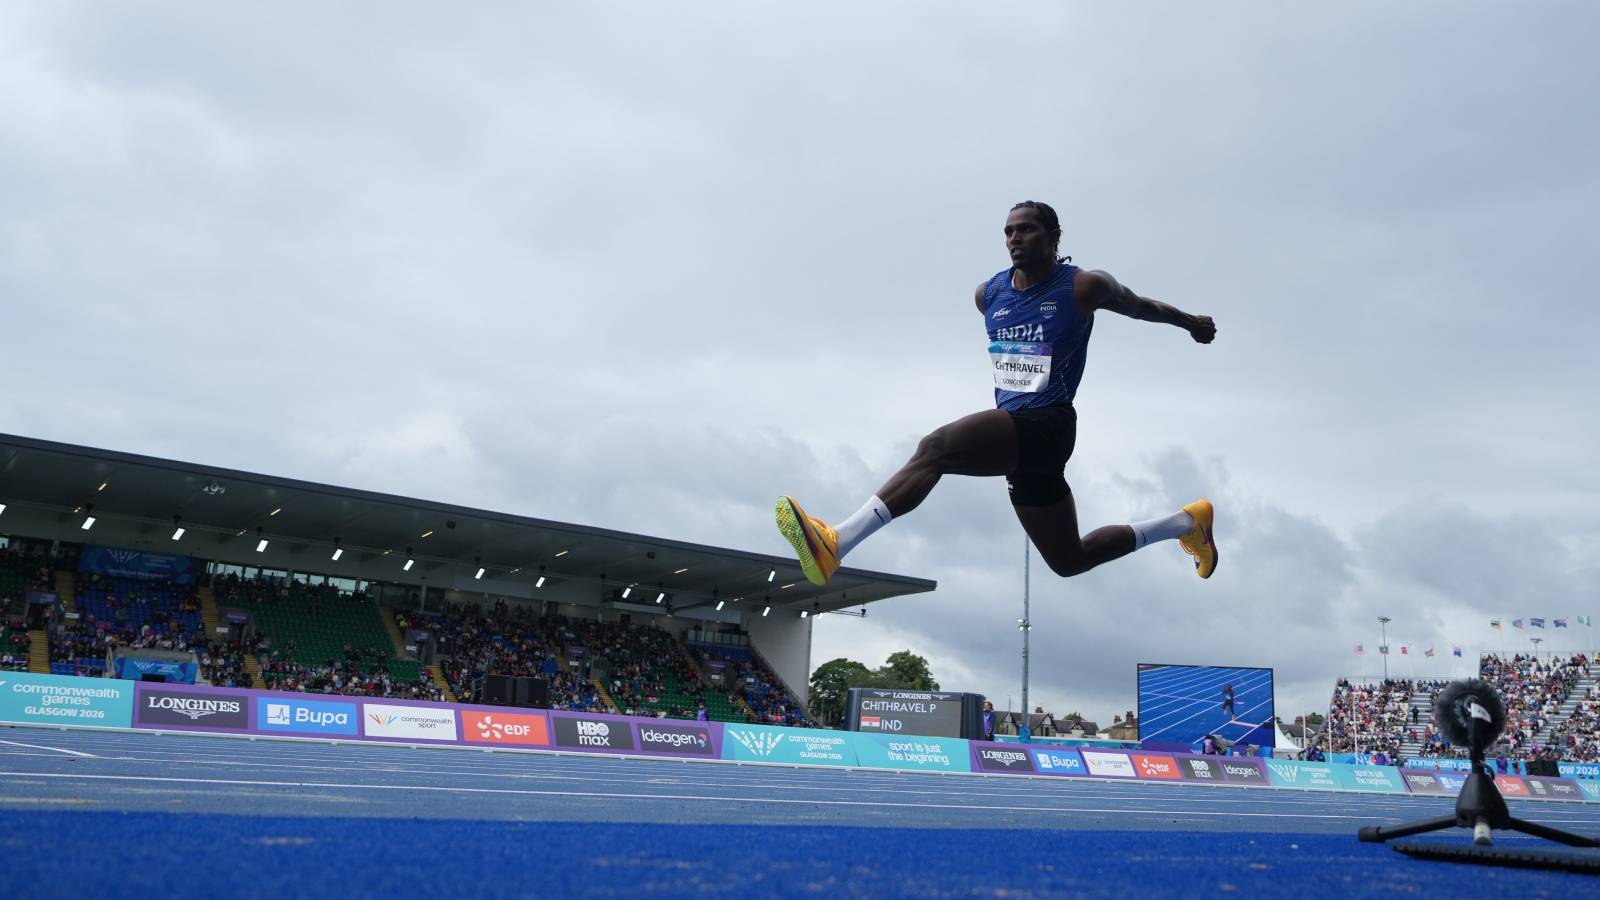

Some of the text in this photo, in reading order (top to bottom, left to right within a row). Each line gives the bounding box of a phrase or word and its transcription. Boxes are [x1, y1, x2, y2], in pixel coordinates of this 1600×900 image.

[996, 323, 1044, 341] INDIA
[995, 360, 1045, 374] CHTHRAVEL
[12, 683, 120, 699] commonwealth
[893, 692, 932, 700] LONGINES
[42, 694, 91, 706] games
[148, 696, 240, 713] LONGINES
[24, 706, 105, 719] GLASGOW 2026
[861, 700, 937, 713] CHITHRAVEL P
[295, 707, 348, 726] Bupa
[401, 716, 453, 725] commonwealth
[418, 722, 437, 730] sport
[576, 721, 610, 737] HBO
[881, 719, 903, 731] IND
[578, 735, 611, 747] max
[641, 728, 697, 747] Ideagen
[806, 742, 832, 752] games
[888, 742, 941, 754] sport is just
[887, 751, 950, 766] the beginning
[981, 750, 1027, 761] LONGINES
[1051, 756, 1079, 768] Bupa
[1576, 766, 1599, 776] 2026
